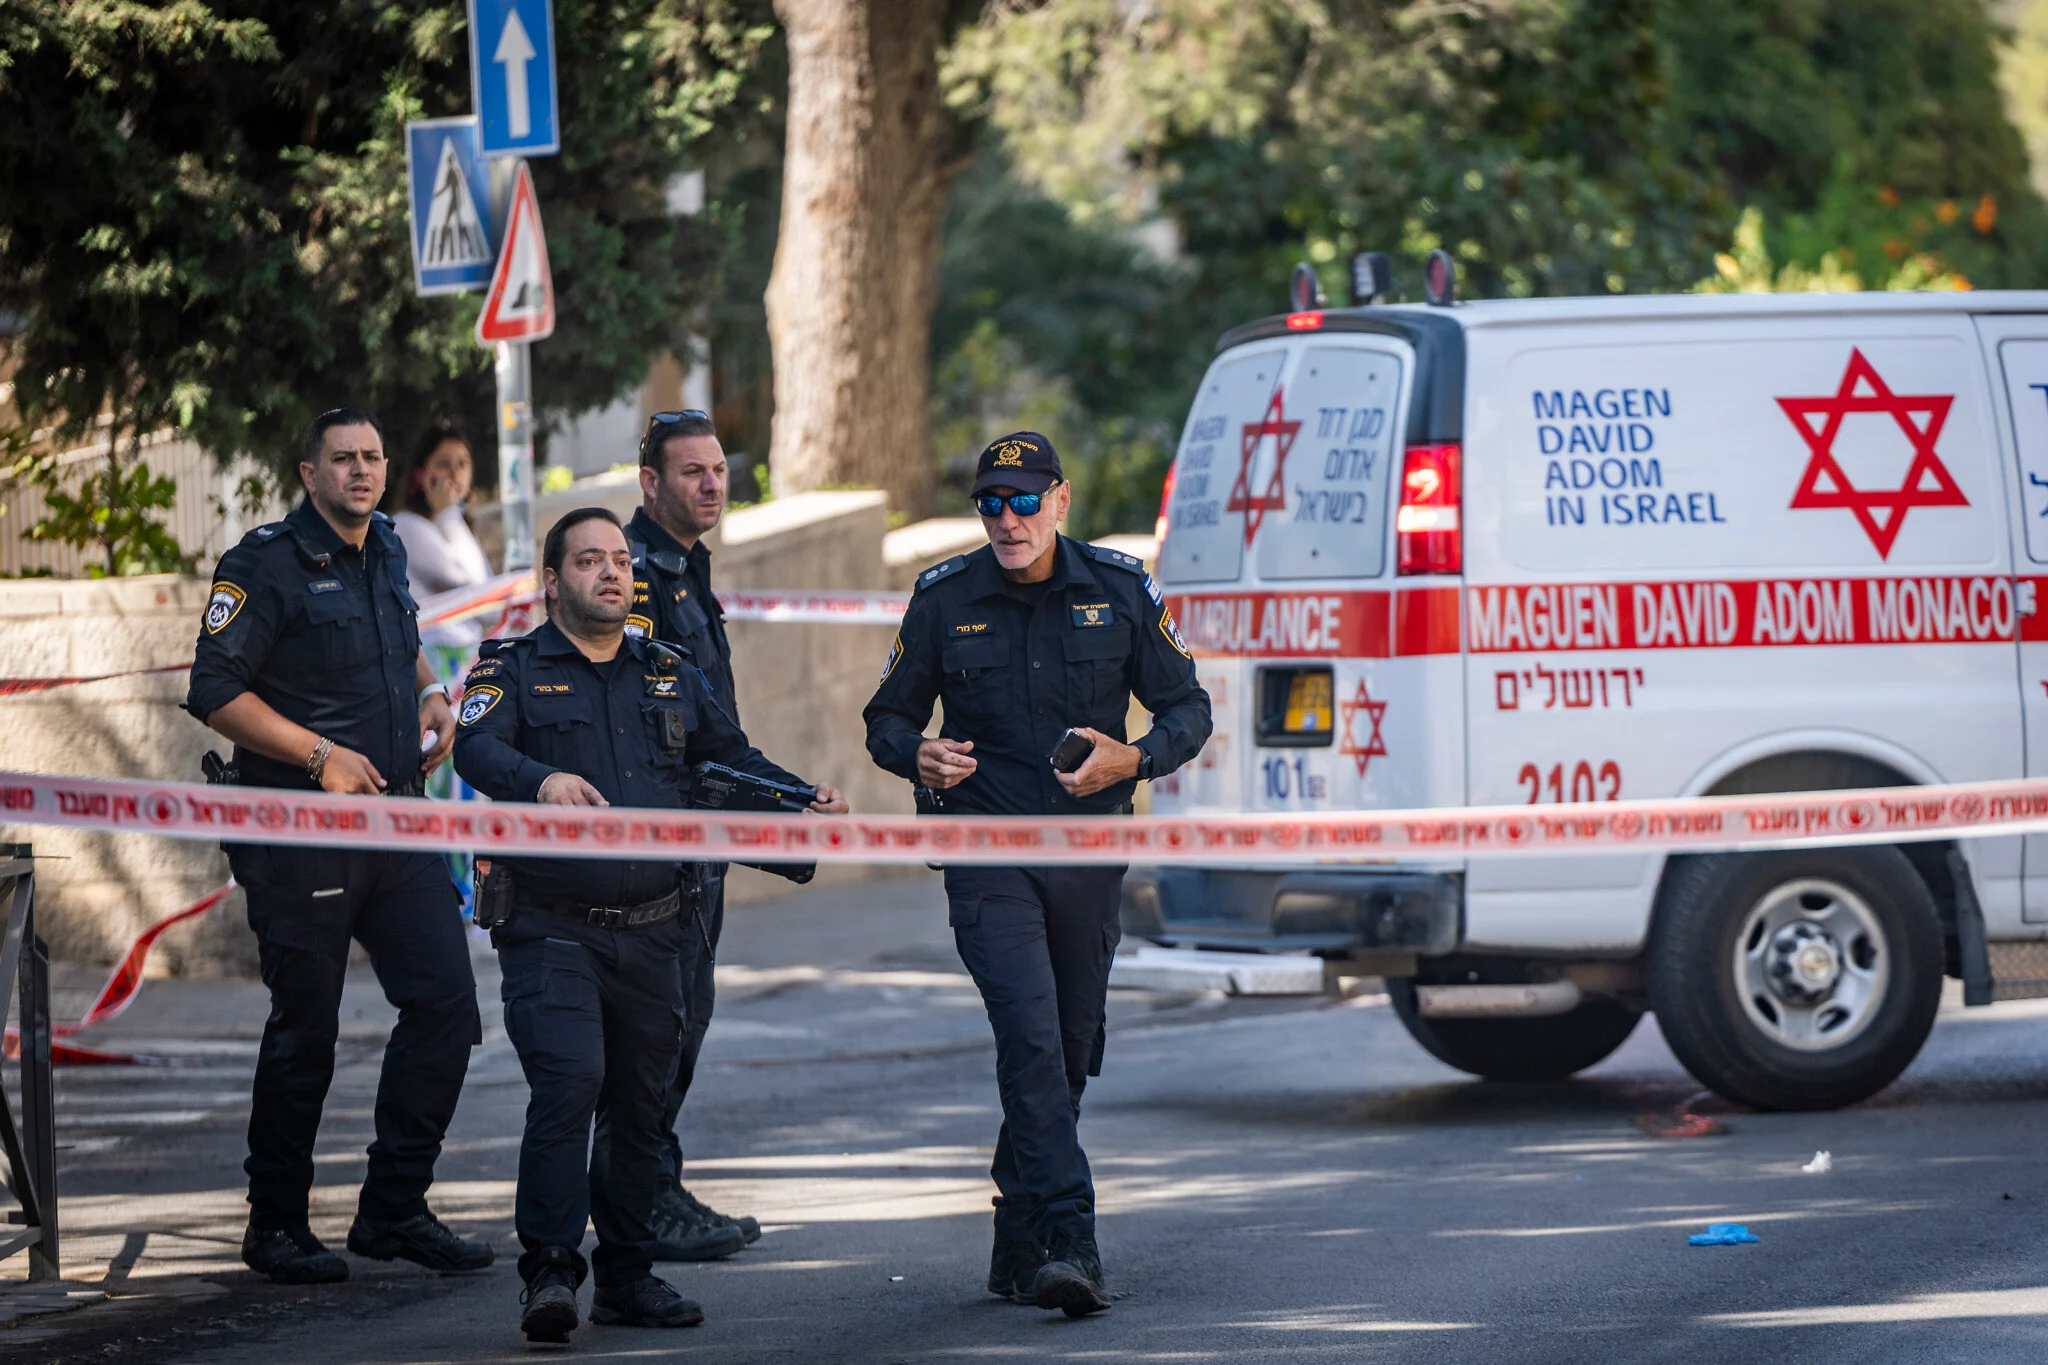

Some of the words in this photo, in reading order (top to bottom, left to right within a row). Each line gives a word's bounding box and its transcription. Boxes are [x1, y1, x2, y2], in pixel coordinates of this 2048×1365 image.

[1532, 388, 1672, 419] MAGEN
[1317, 407, 1348, 439] דוד
[1537, 423, 1655, 454] DAVID
[1324, 448, 1377, 481] אדום
[1545, 458, 1664, 489] ADOM
[1546, 495, 1585, 525] IN
[1600, 492, 1727, 525] ISRAEL
[1179, 597, 1341, 650] AMBULANCE
[1469, 585, 1620, 649] MAGUEN
[1633, 583, 1738, 646] DAVID
[1752, 580, 1854, 643] ADOM
[1866, 577, 2014, 641] MONACO
[1495, 661, 1644, 710] ירושלים
[1262, 756, 1303, 798] 101
